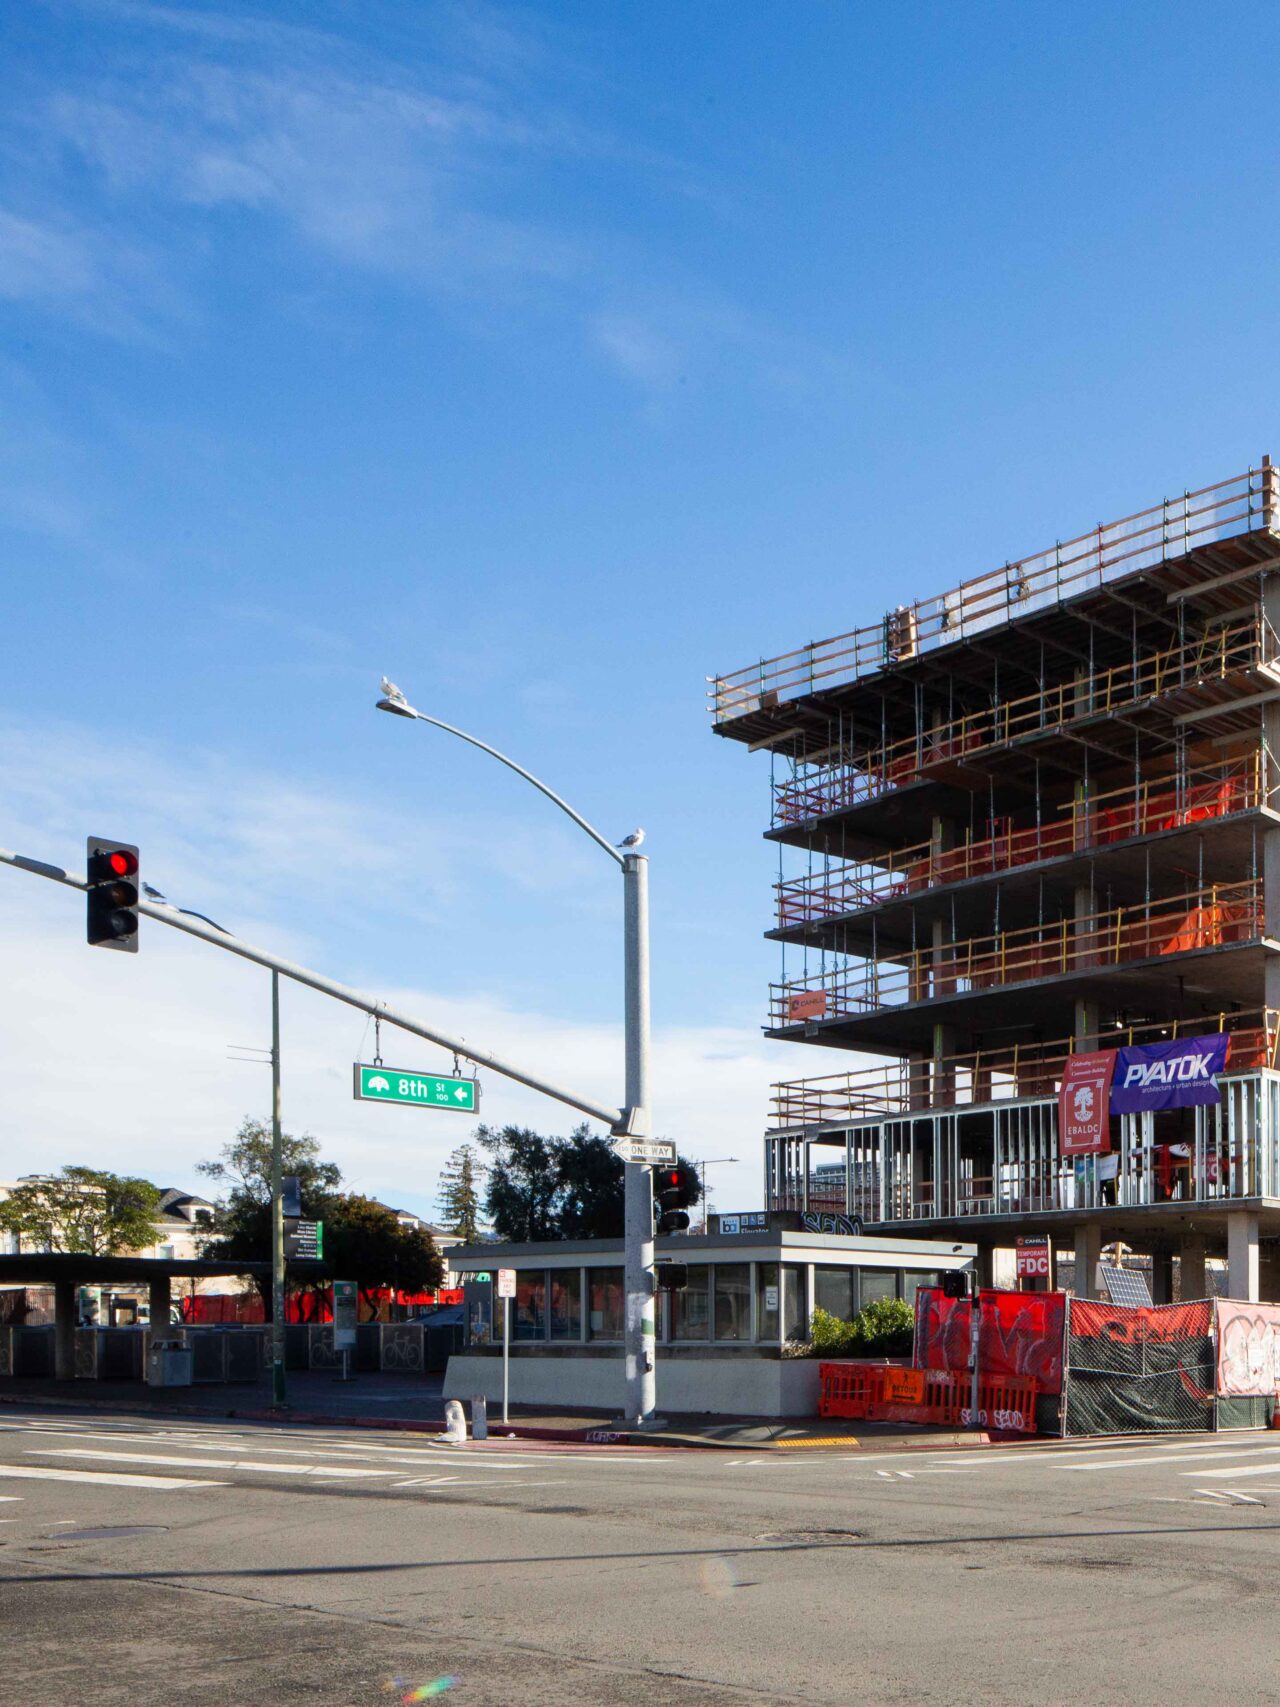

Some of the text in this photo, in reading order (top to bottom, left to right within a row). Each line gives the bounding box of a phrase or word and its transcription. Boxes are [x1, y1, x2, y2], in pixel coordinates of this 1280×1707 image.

[1123, 1053, 1214, 1088] PYATOK
[398, 1079, 445, 1098] 8th St
[1142, 1085, 1171, 1094] architecture
[1193, 1080, 1210, 1088] design
[1067, 1124, 1099, 1135] EBALDC
[631, 1146, 648, 1155] ONE
[652, 1146, 669, 1156] WAY
[1018, 1257, 1048, 1273] FDC
